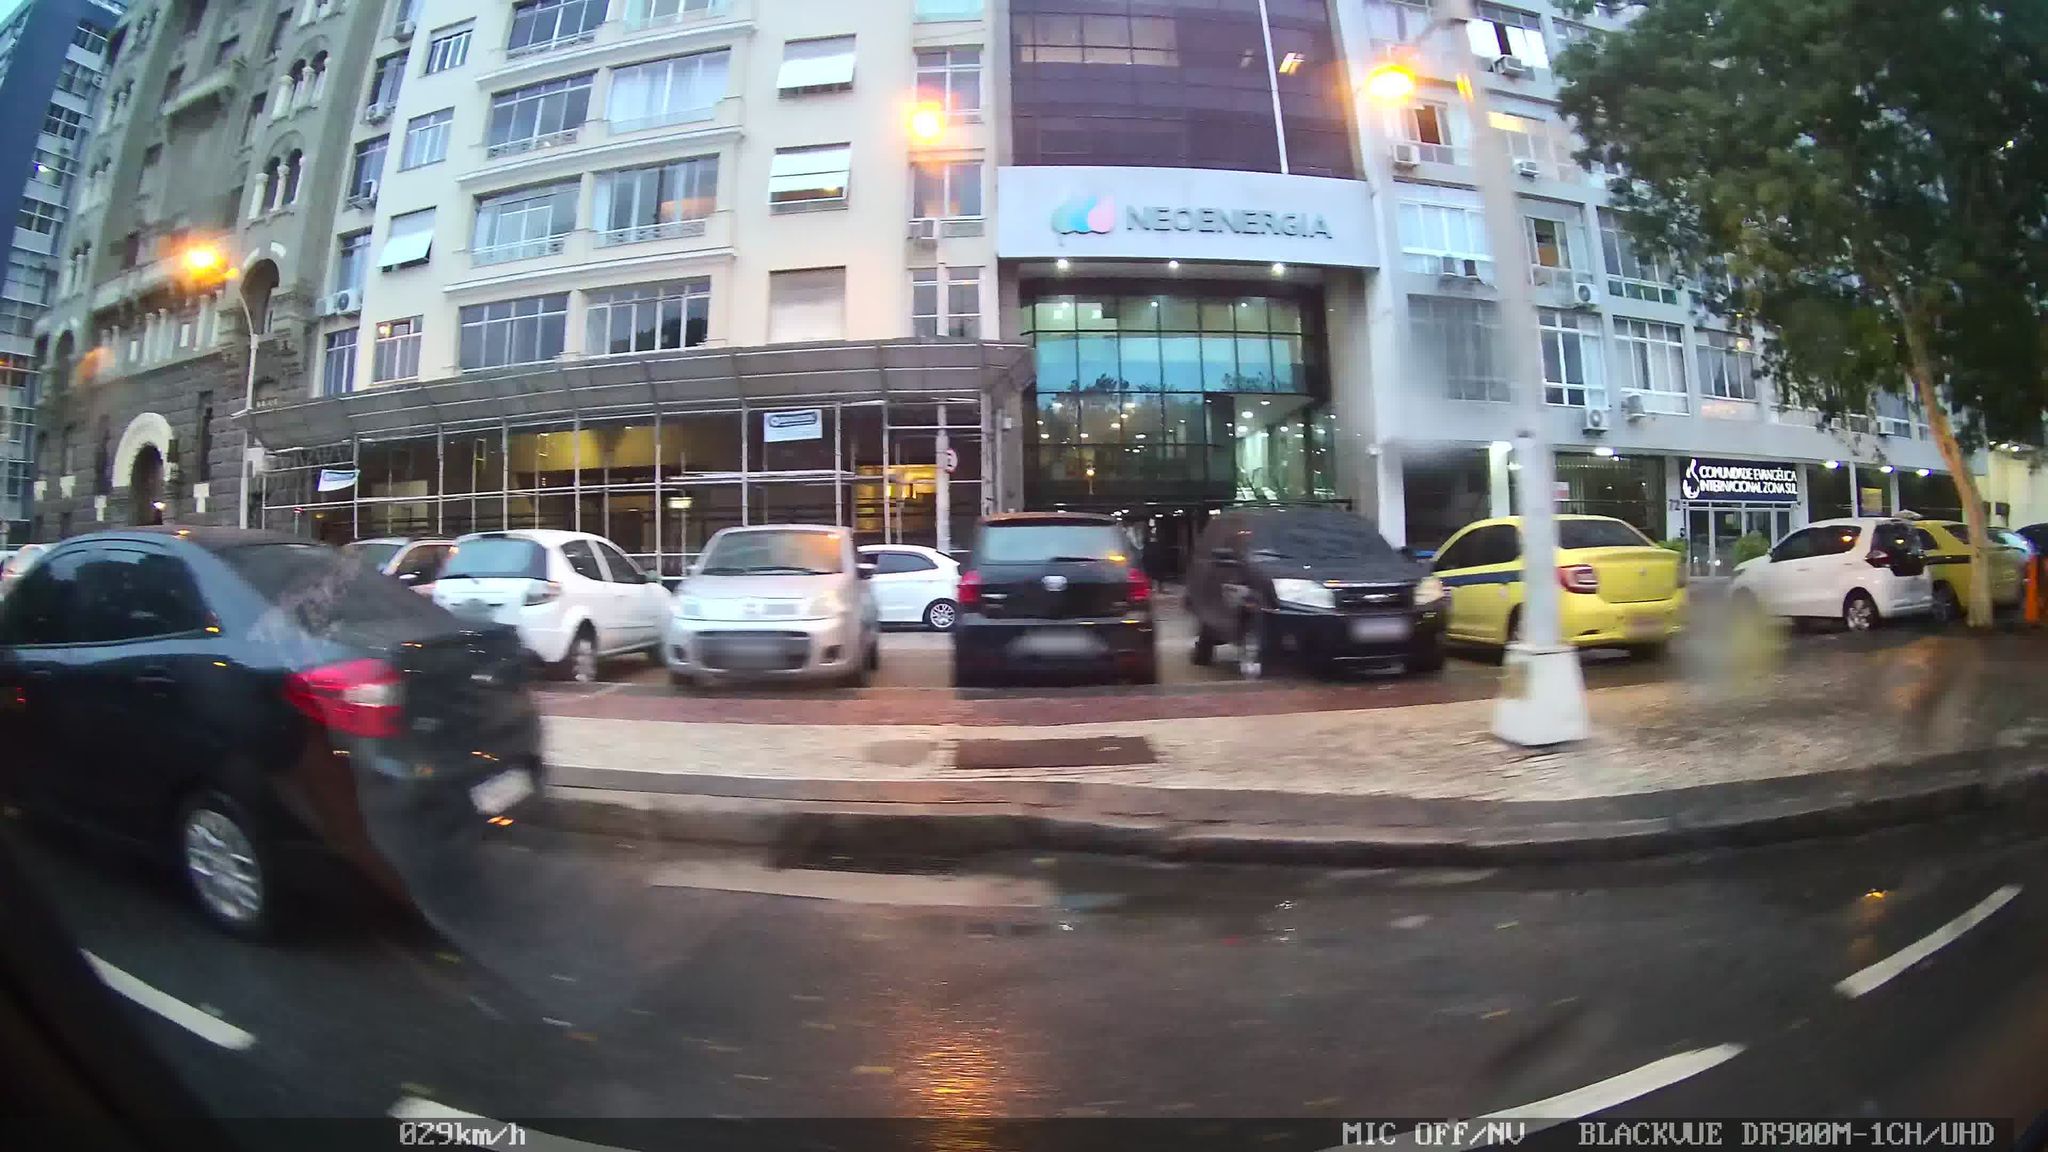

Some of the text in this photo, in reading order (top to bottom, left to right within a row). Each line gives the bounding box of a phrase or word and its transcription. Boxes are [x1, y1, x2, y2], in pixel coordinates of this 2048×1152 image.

[1125, 205, 1333, 240] NEOENERGIA
[1699, 479, 1798, 495] INTERNACIONAL ZONA SUL
